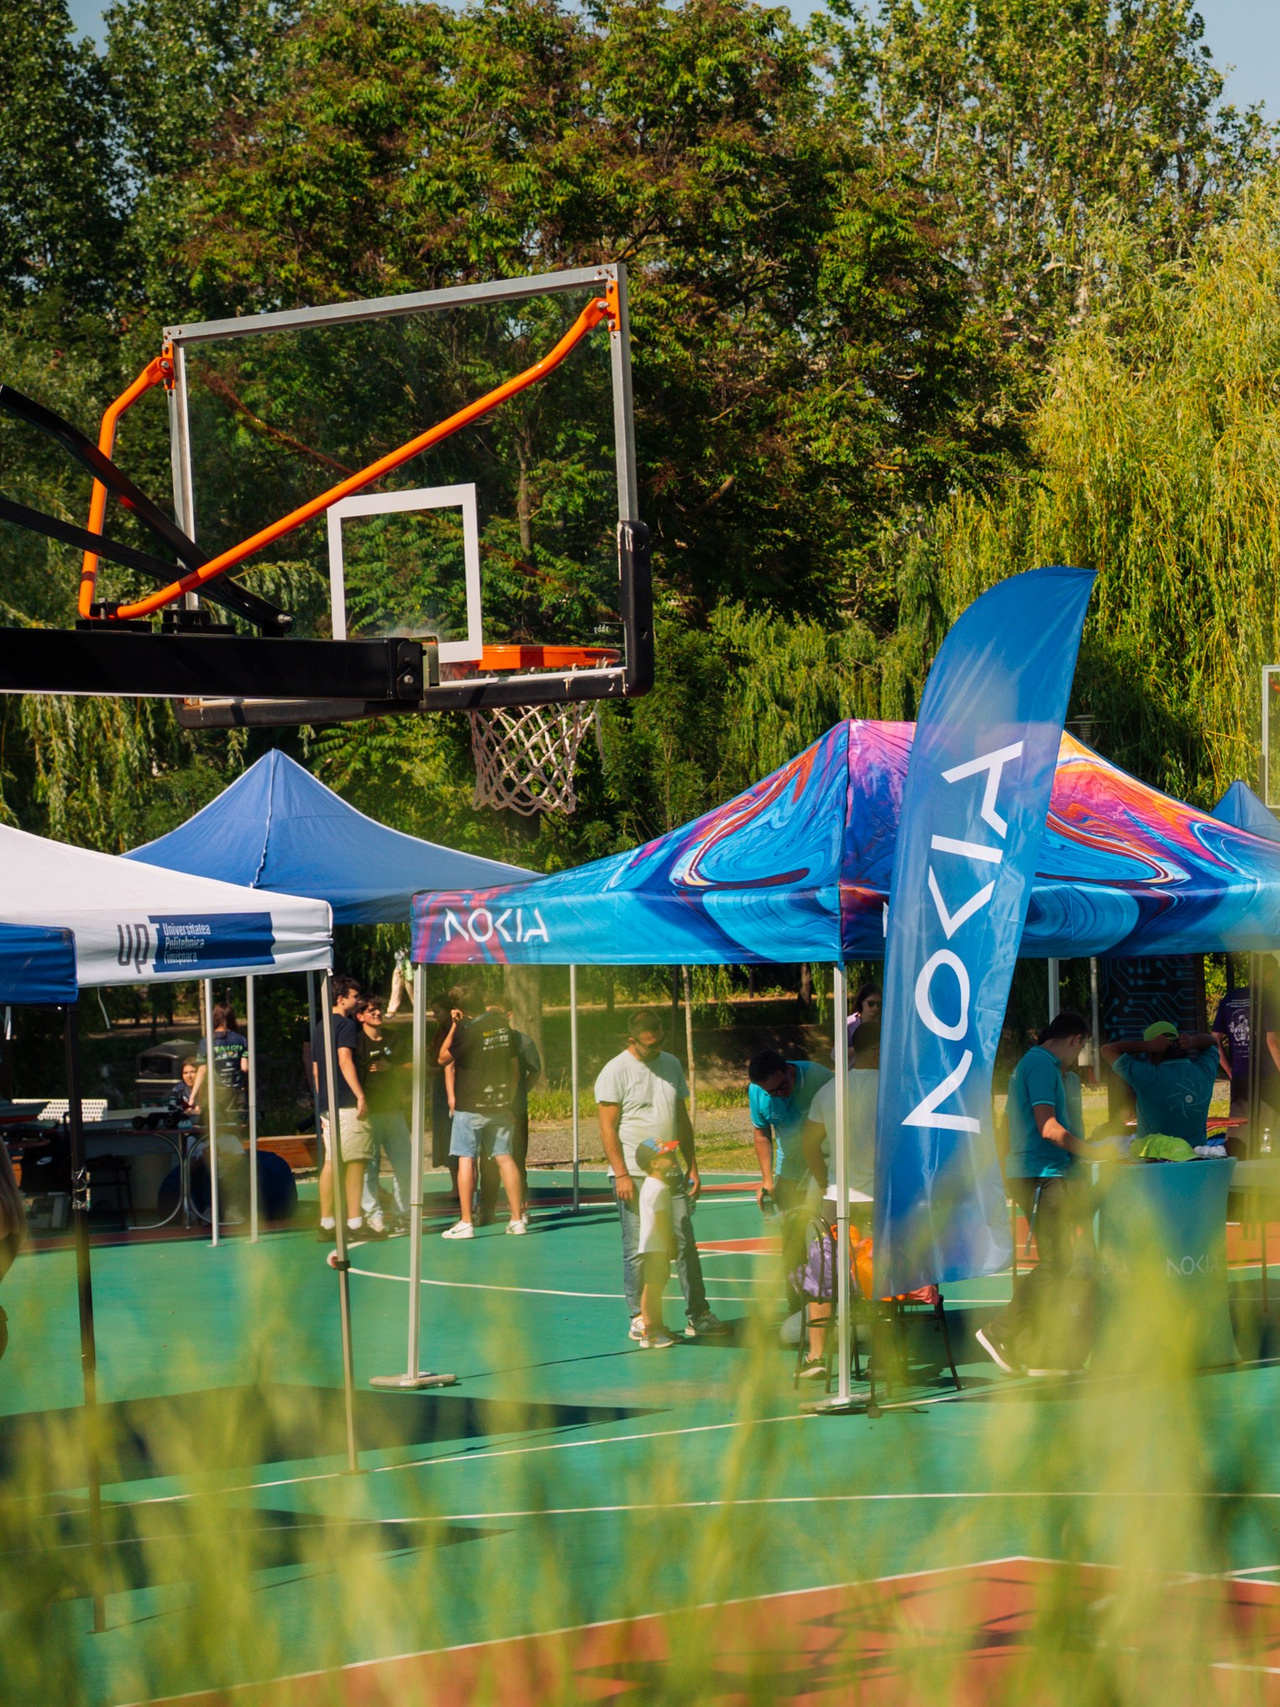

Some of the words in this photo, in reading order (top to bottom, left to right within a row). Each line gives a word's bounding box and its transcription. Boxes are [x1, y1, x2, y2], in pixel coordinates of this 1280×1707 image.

[162, 923, 211, 936] Universitatea
[444, 907, 549, 942] NOKIA
[901, 741, 1024, 1134] NOKIA
